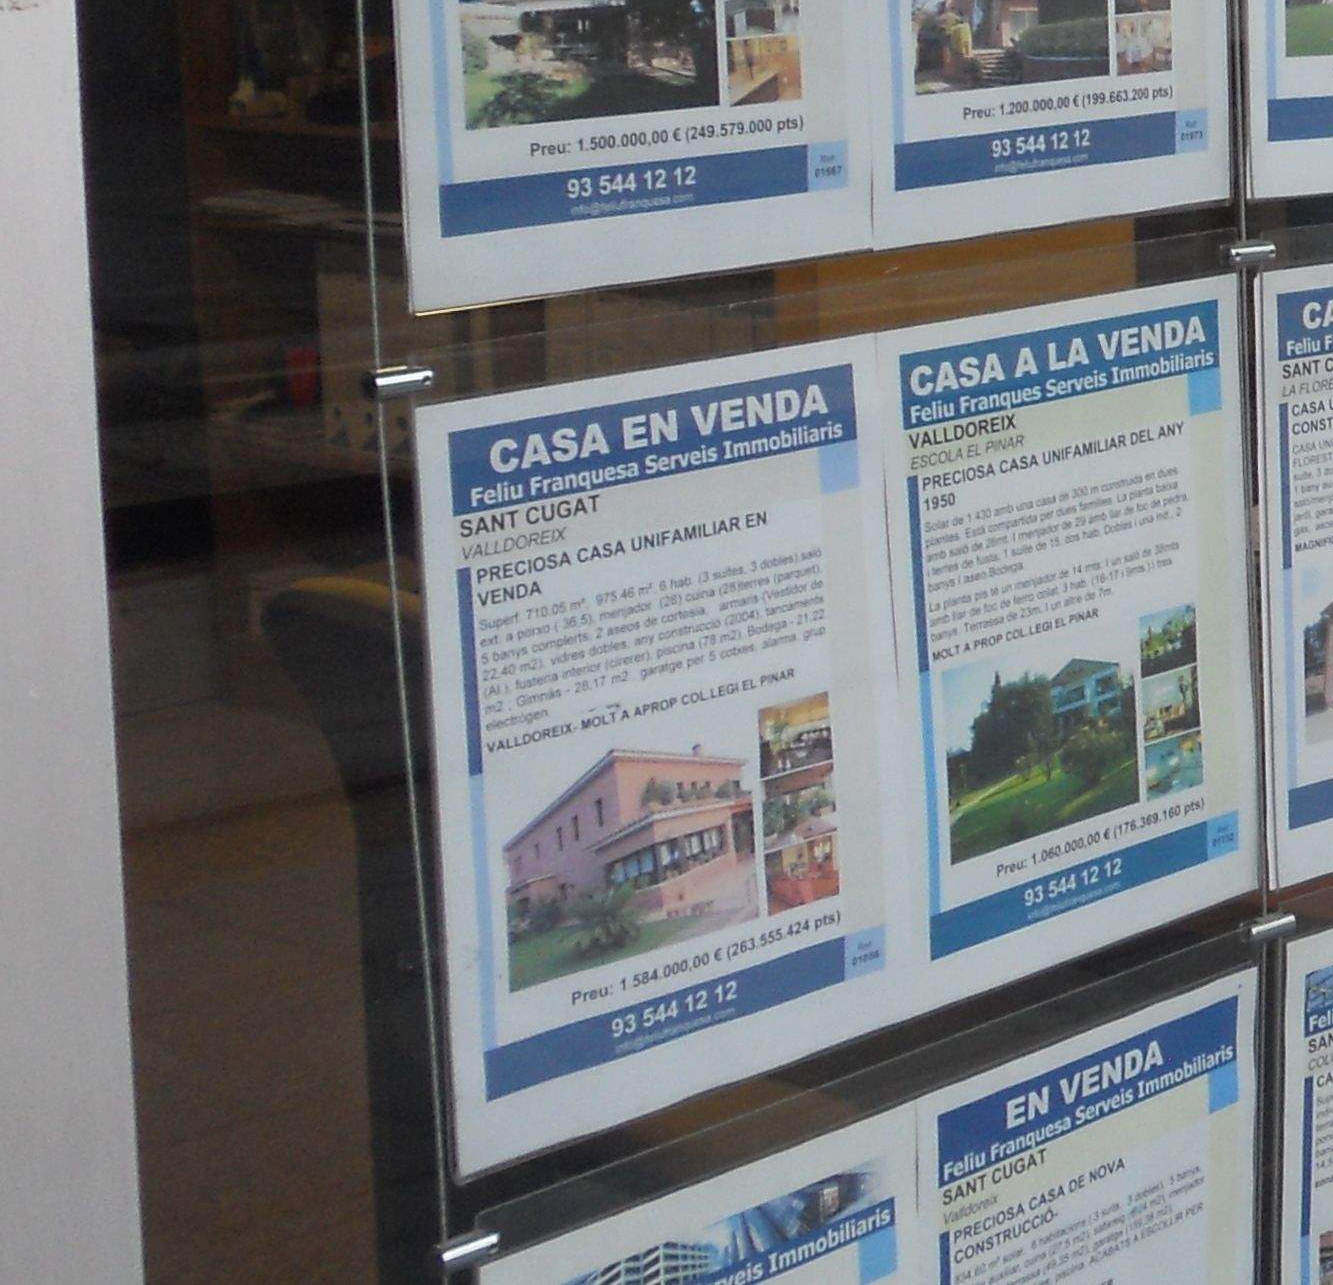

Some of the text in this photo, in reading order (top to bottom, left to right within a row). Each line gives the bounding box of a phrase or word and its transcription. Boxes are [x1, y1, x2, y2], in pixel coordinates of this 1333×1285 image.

[567, 166, 695, 199] 93 544 12 12
[910, 316, 1205, 397] CASA A LA VENDA
[490, 383, 828, 475] CASA EN VENDA
[909, 414, 1016, 449] VALLDOREIX
[470, 421, 842, 507] Feliu Franquesa Serveis Immobiliaris
[460, 495, 601, 538] SANT CUGAT
[462, 528, 566, 560] VALLDOREIX
[477, 513, 768, 584] PRECIOSA CASA UNIFAMILIAR EN
[477, 582, 541, 607] VENDA
[1004, 1041, 1163, 1129] EN VENDA
[942, 1150, 1047, 1205] SANT CUGAT
[769, 1207, 890, 1271] Immobiliaris
